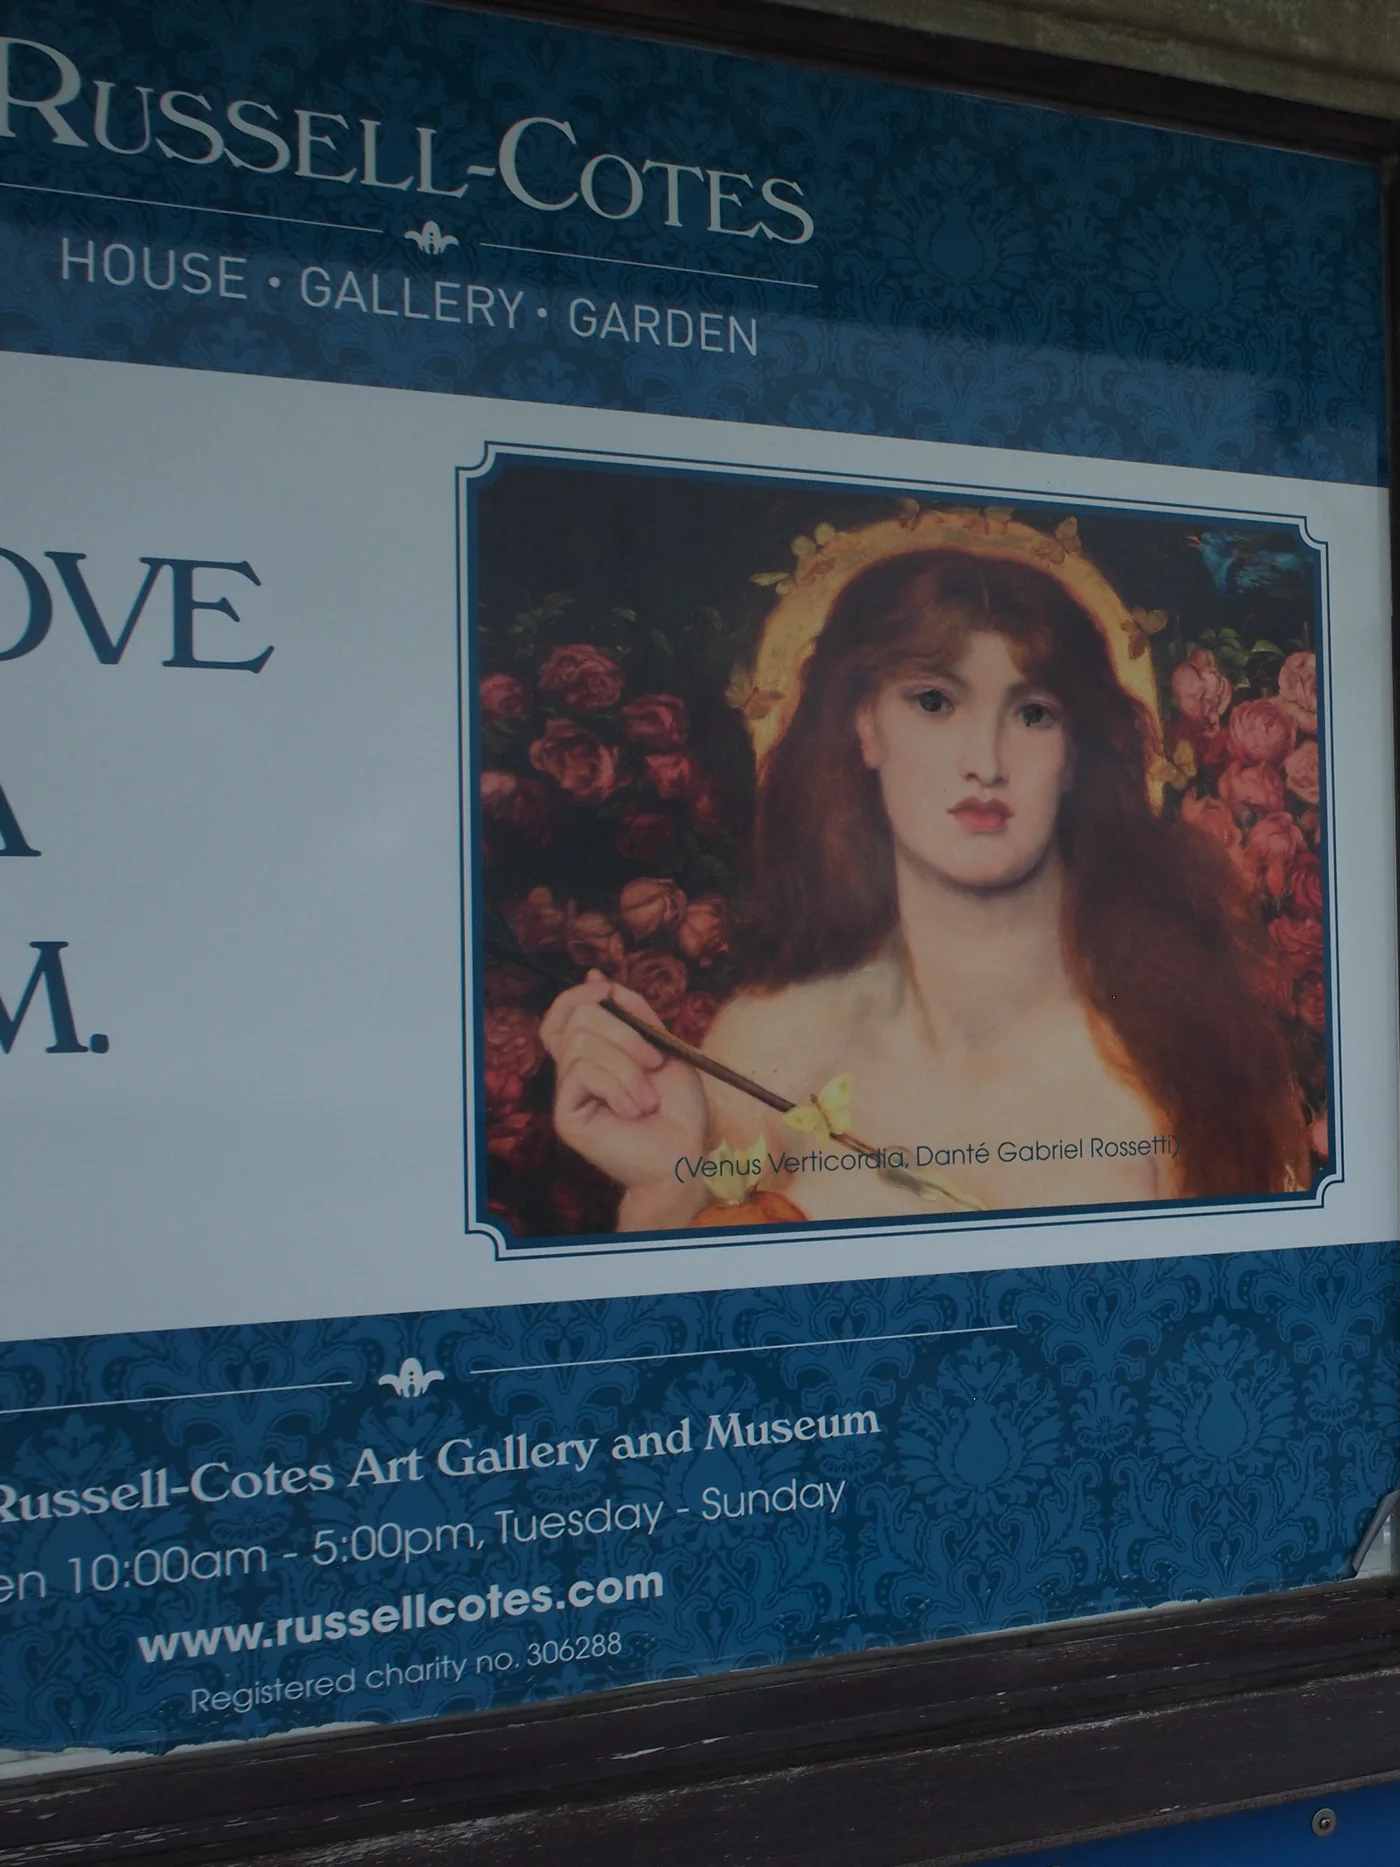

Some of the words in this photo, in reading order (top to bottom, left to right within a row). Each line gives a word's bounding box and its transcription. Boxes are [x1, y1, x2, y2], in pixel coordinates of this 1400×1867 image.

[61, 237, 248, 300] HOUSE
[300, 267, 526, 329] GALLERY
[568, 298, 758, 357] GARDEN
[674, 1156, 762, 1184] (Venus
[767, 1147, 909, 1175] Verticordia,
[916, 1142, 990, 1167] Danté
[997, 1138, 1083, 1162] Gabriel
[1090, 1135, 1180, 1159] Rossetti)
[0, 1461, 335, 1524] Russell-Cotes
[347, 1448, 424, 1488] Art
[437, 1432, 599, 1477] Gallery
[611, 1417, 692, 1461] and
[704, 1410, 881, 1451] Museum
[68, 1545, 268, 1595] 10:00am
[312, 1522, 485, 1566] 5:00pm,
[494, 1499, 665, 1545] Tuesday
[702, 1478, 847, 1522] Sunday
[138, 1571, 664, 1664] www.russellcotes.com
[190, 1668, 356, 1714] Registered
[365, 1652, 466, 1690] charity
[476, 1652, 519, 1675] no.
[527, 1631, 623, 1668] 306288
